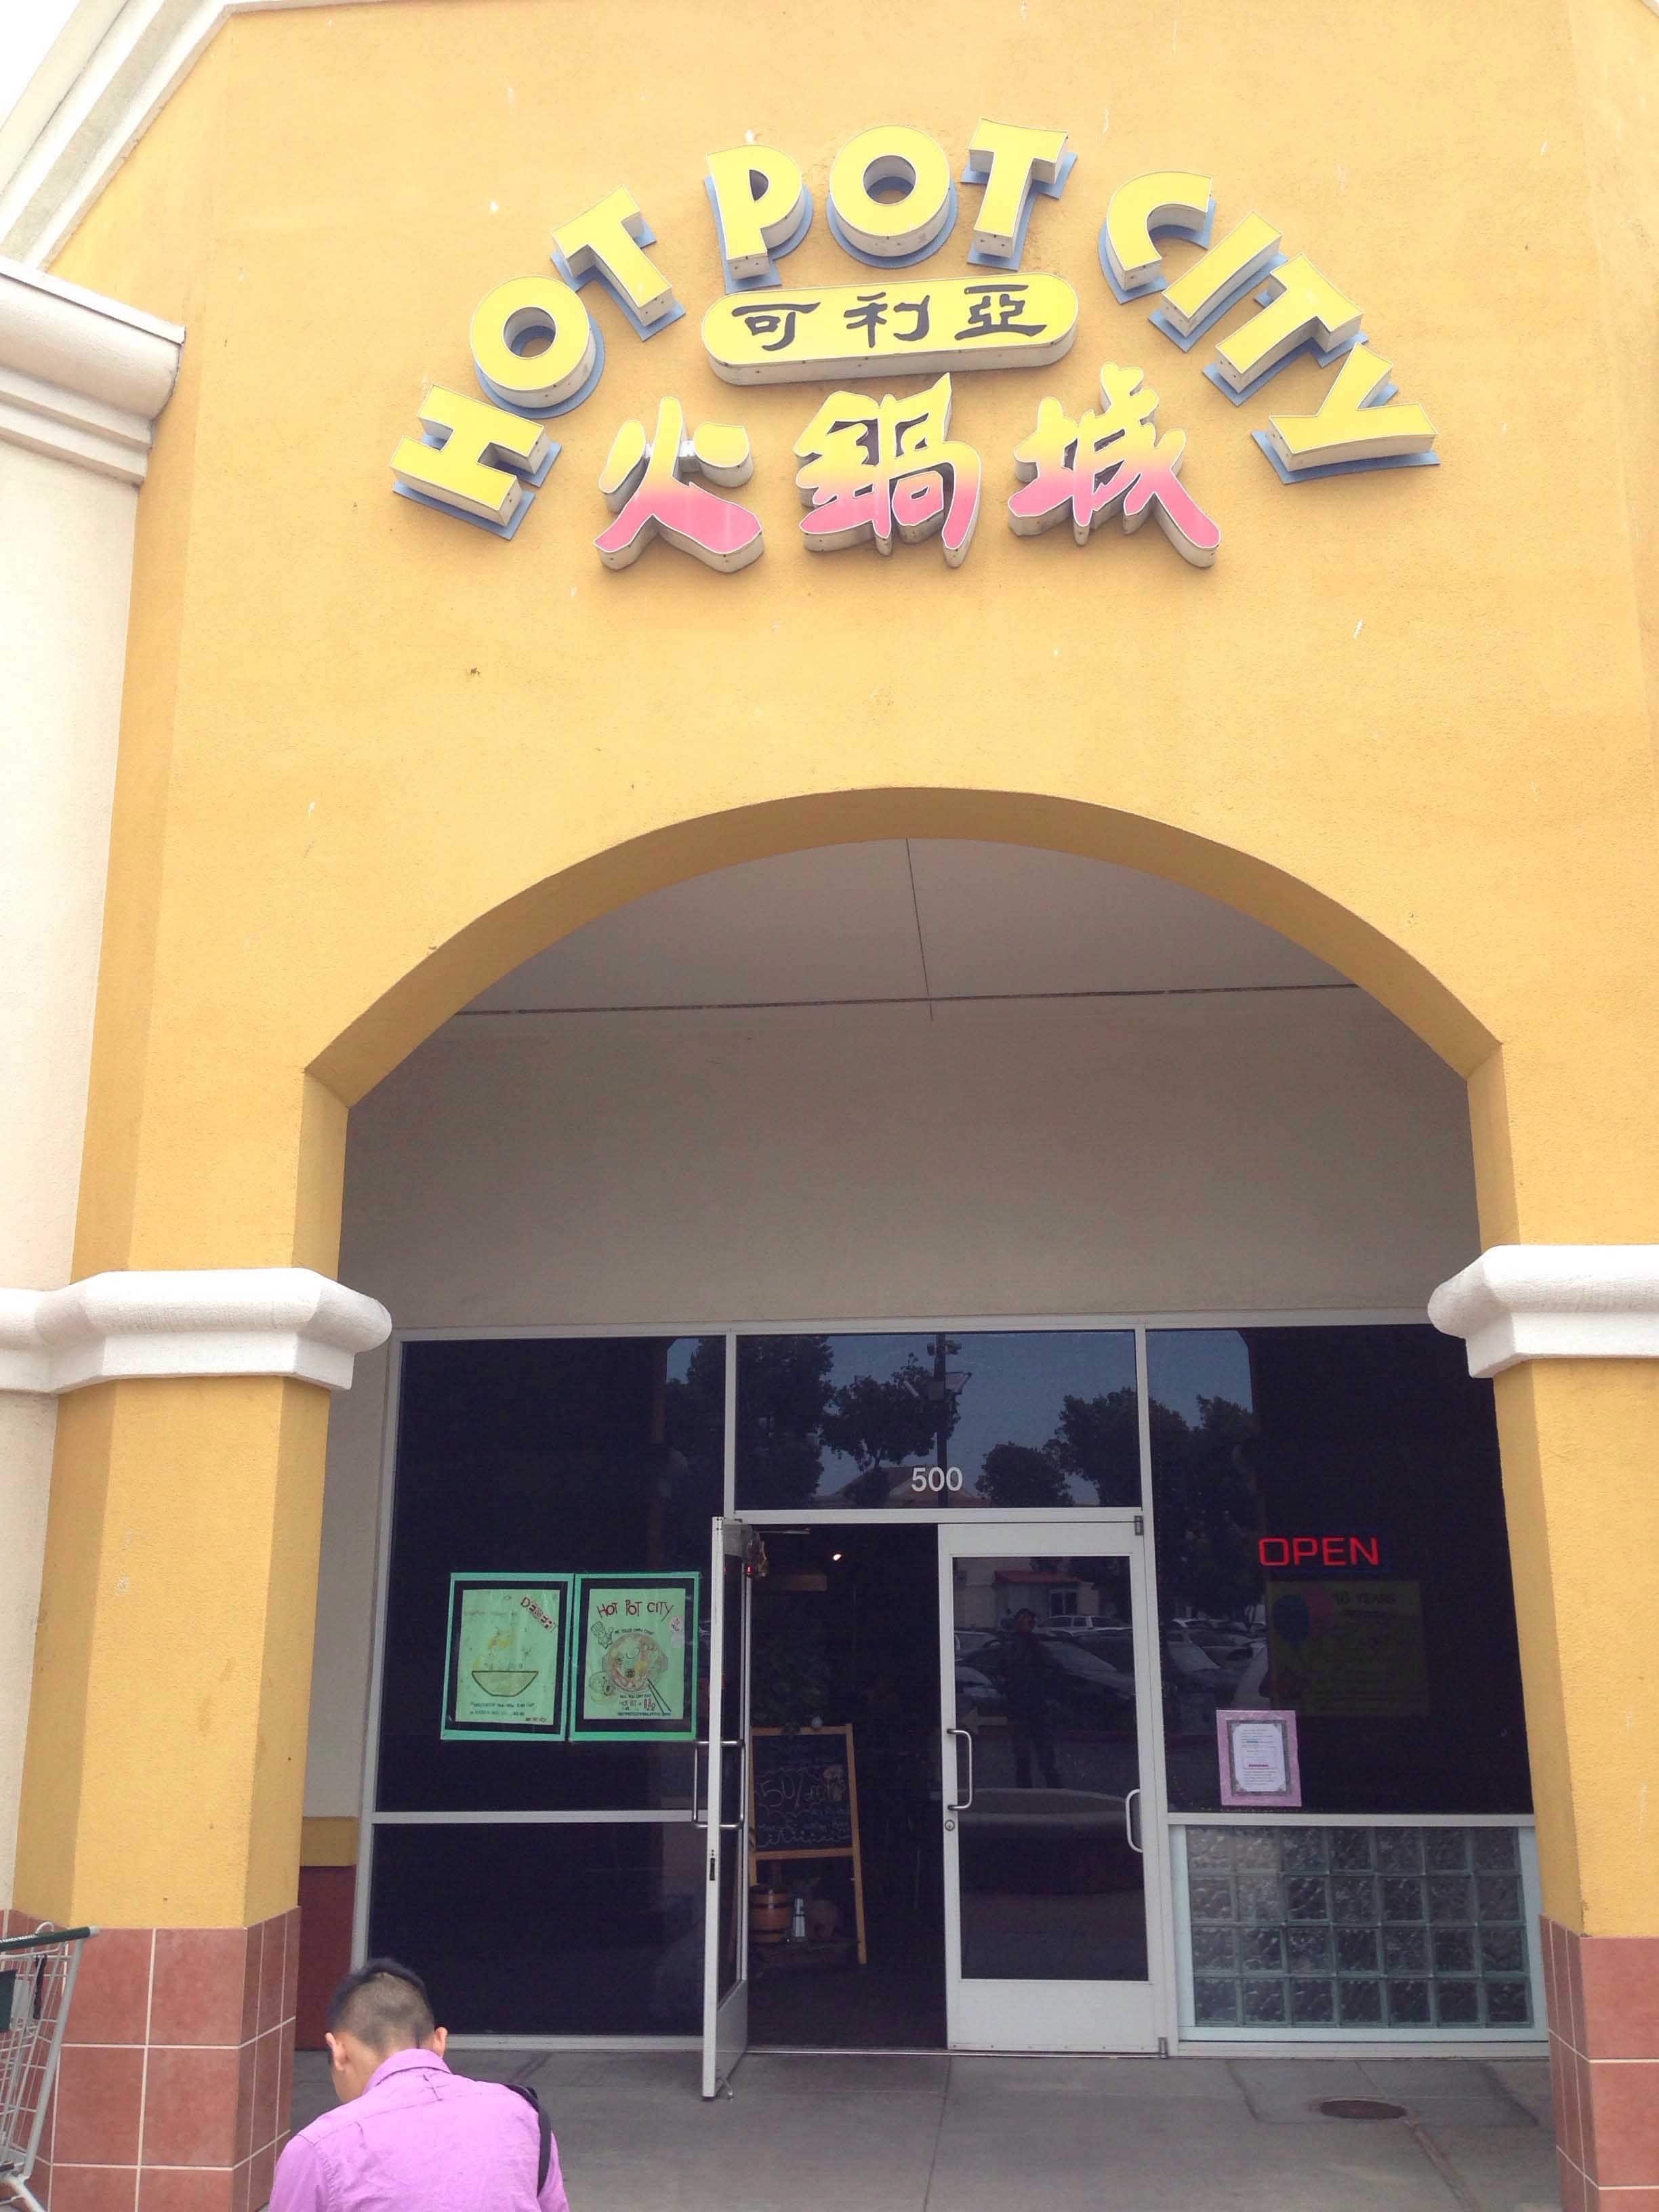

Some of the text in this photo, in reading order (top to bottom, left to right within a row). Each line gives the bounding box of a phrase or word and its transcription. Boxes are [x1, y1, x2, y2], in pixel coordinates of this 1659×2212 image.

[390, 119, 1438, 534] HOT POT CITY
[732, 285, 1047, 351] 可利亞
[594, 361, 1221, 567] 火鍋城
[911, 1467, 963, 1492] 500
[1258, 1536, 1380, 1567] OPEN
[596, 1599, 674, 1621] HOT POT CITY
